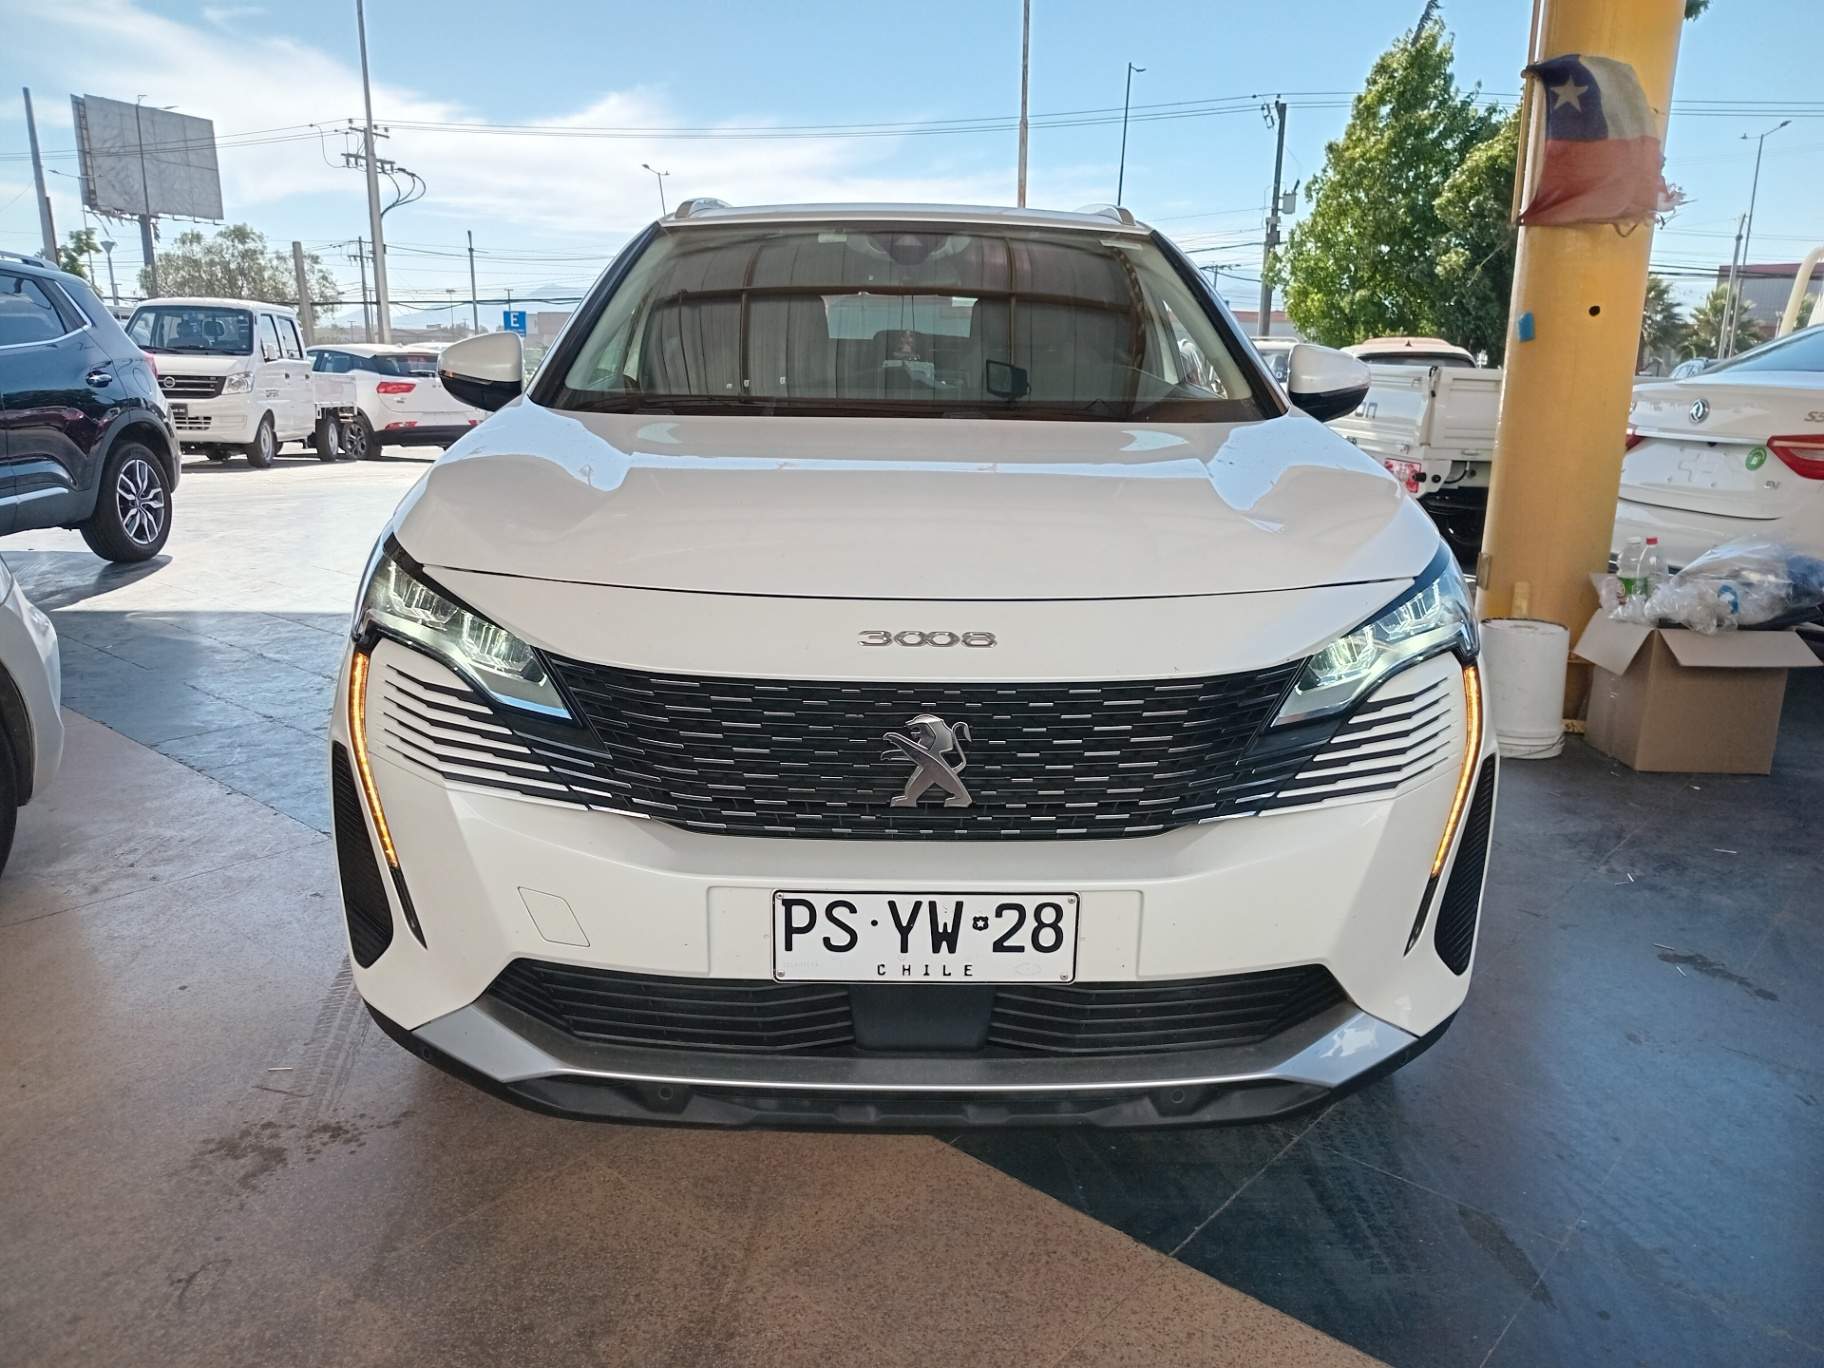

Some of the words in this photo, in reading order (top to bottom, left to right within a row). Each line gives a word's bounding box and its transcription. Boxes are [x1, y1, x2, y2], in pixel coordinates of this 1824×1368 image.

[510, 312, 520, 327] E
[857, 630, 998, 648] 3008
[877, 963, 973, 977] CHILE
